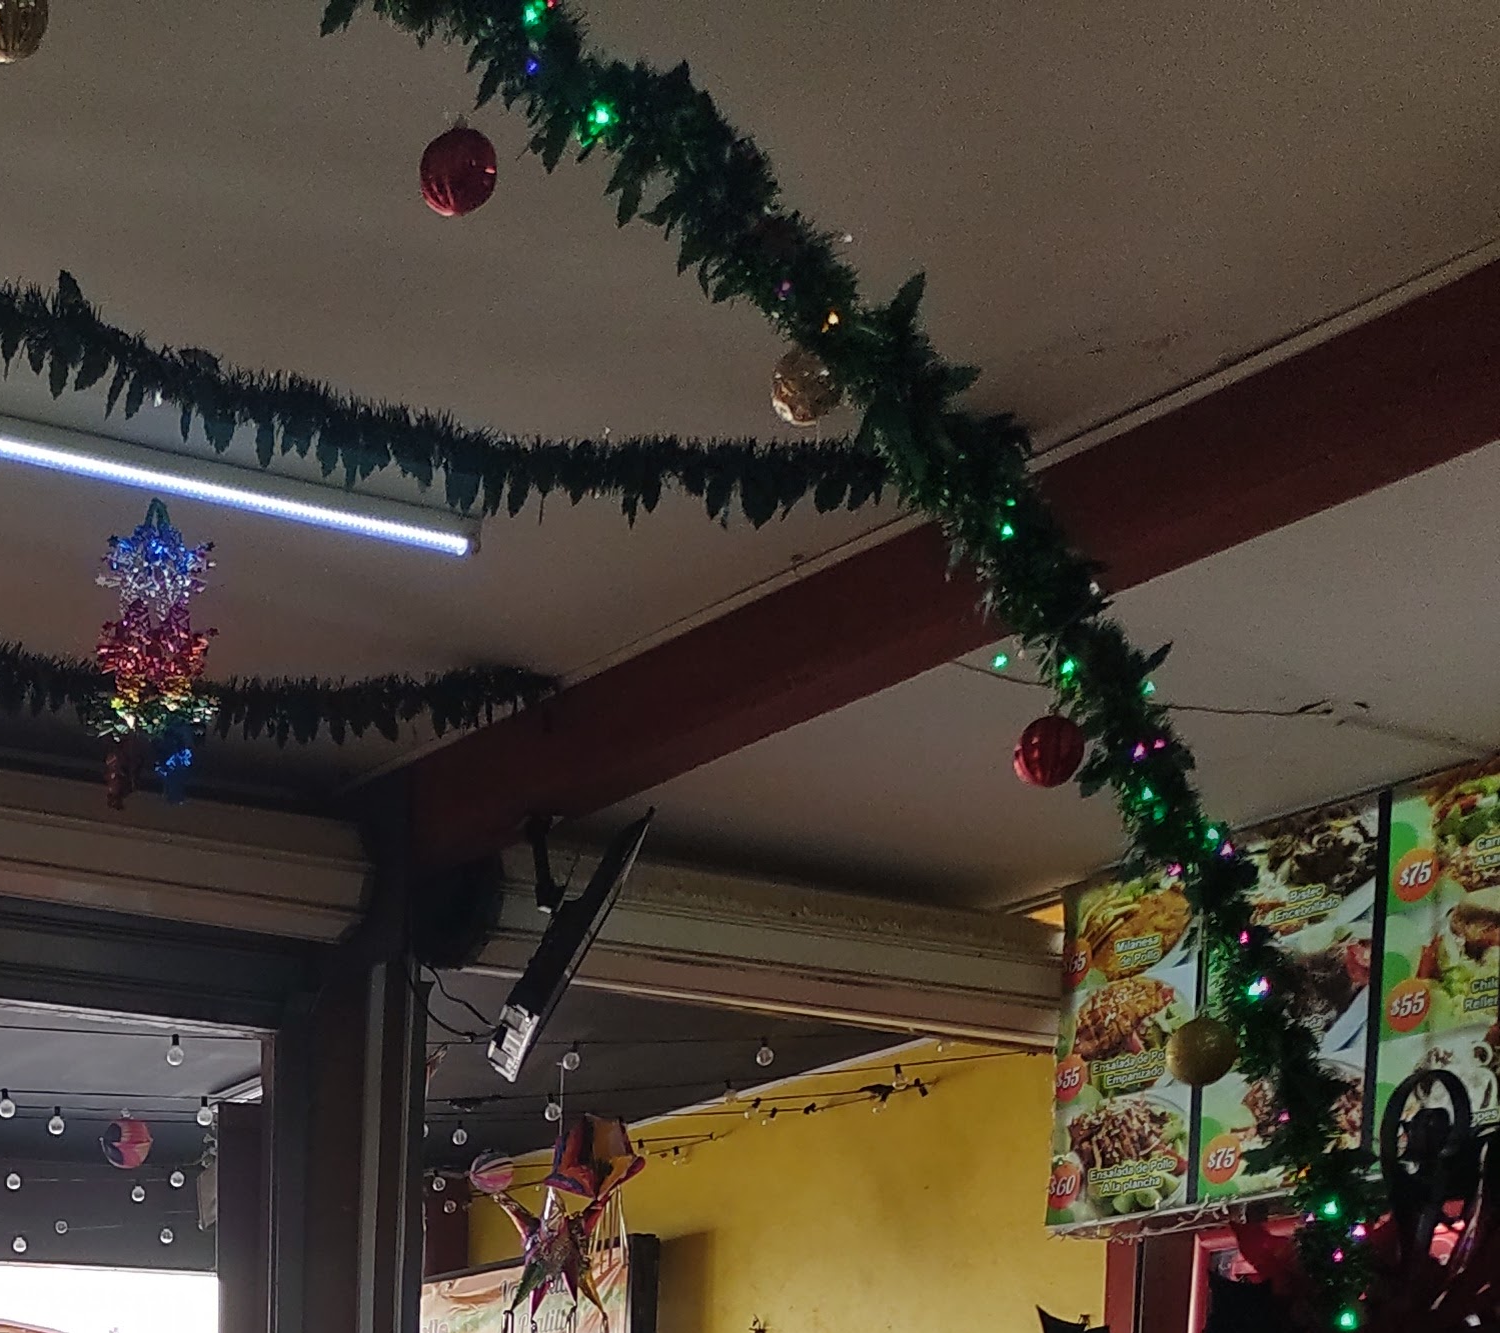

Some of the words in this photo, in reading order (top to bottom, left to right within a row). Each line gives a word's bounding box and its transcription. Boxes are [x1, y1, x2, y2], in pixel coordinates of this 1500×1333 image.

[1399, 858, 1433, 887] $75
[1115, 935, 1160, 951] Milanesa
[1120, 954, 1132, 967] de
[1134, 949, 1160, 963] Pollo
[1390, 991, 1425, 1019] $55
[1092, 1055, 1136, 1073] Ensalada
[1137, 1052, 1150, 1066] de
[1057, 1066, 1080, 1089] $55
[1106, 1066, 1164, 1086] Empanizado
[1207, 1147, 1235, 1170] $75
[1089, 1166, 1134, 1183] Ensalada
[1135, 1161, 1148, 1174] de
[1150, 1158, 1175, 1171] Pollo
[1050, 1174, 1076, 1197] $60
[1102, 1182, 1111, 1194] A
[1112, 1181, 1121, 1192] la
[1123, 1175, 1160, 1192] plancha
